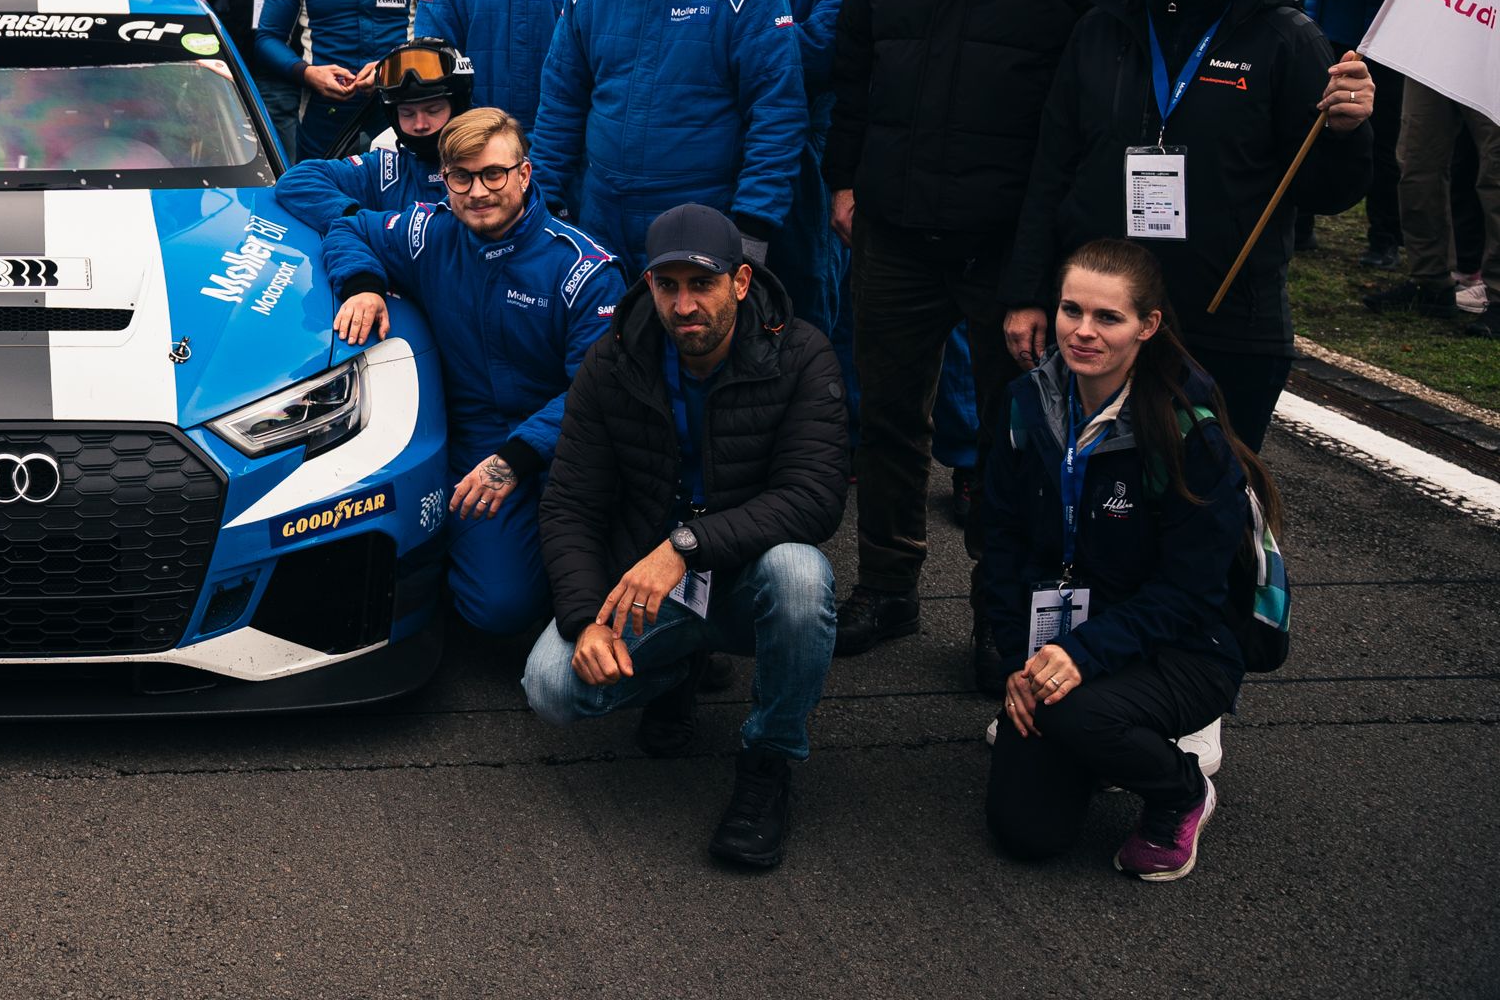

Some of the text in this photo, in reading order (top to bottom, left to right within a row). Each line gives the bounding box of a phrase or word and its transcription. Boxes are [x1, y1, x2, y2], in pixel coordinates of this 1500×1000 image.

[4, 29, 90, 40] SIMULATOR
[1240, 62, 1252, 72] Bil
[243, 215, 288, 241] Bil
[412, 211, 426, 247] sparco
[251, 261, 298, 316] Motorsport
[564, 259, 593, 297] sparco
[537, 297, 549, 308] Bil
[282, 493, 386, 537] GOODYEAR
